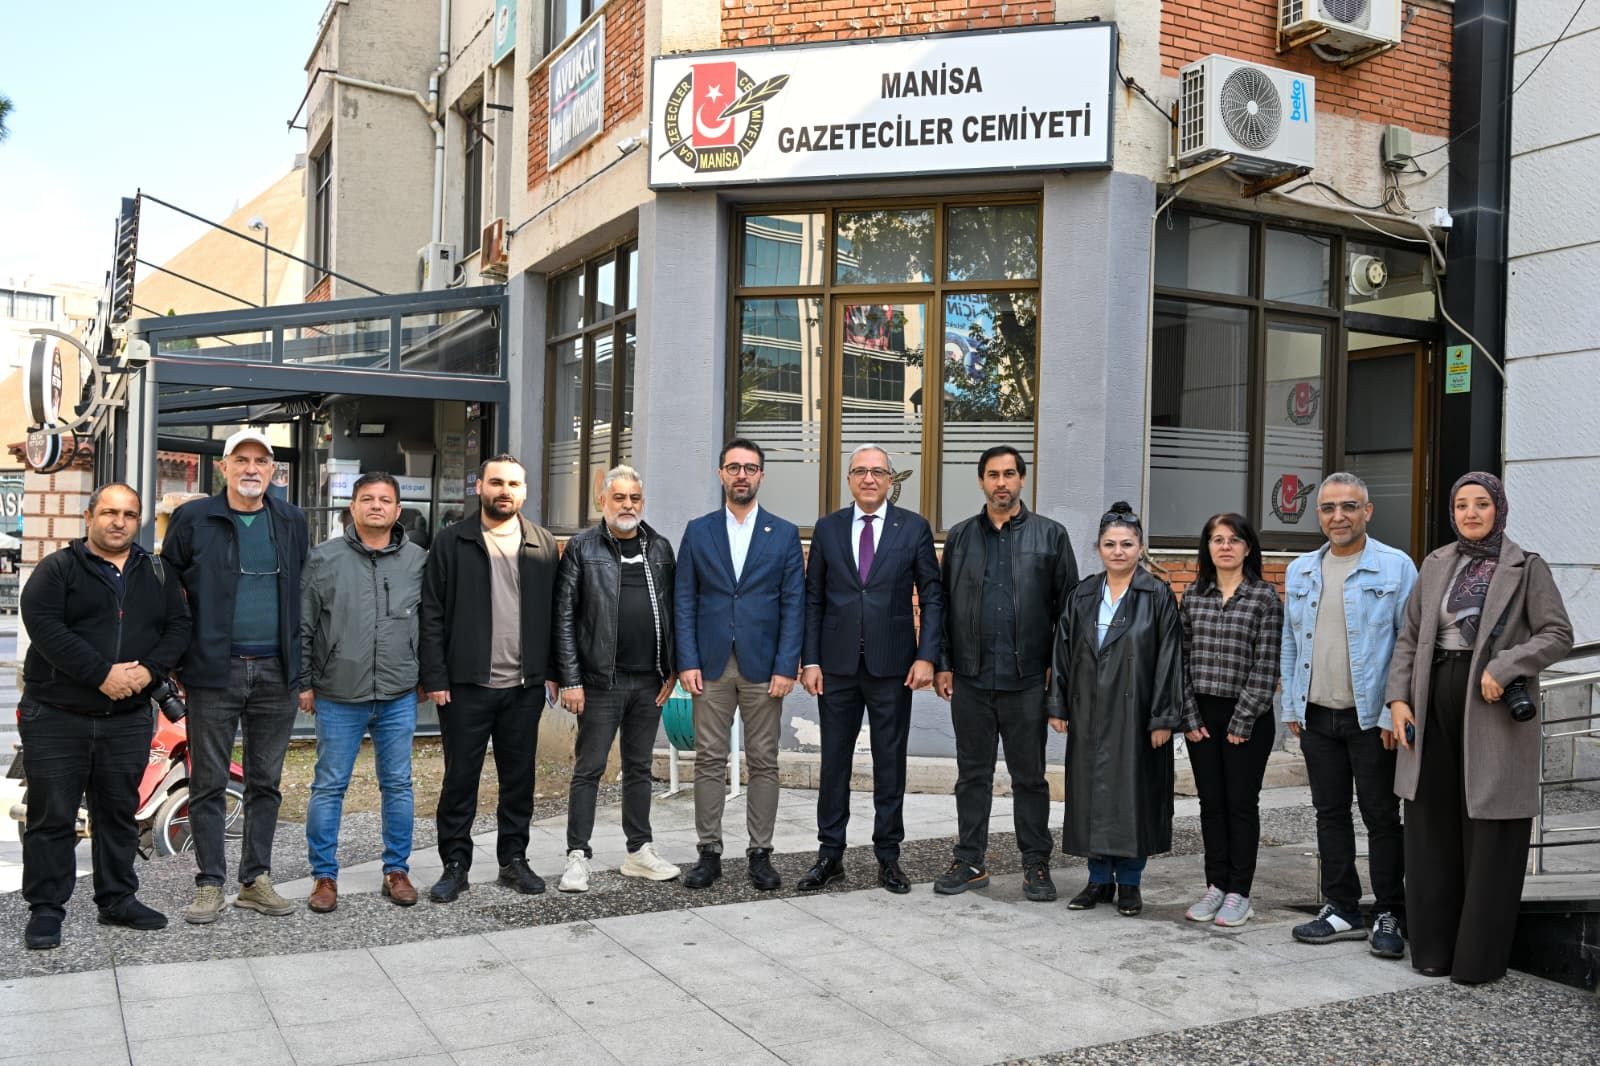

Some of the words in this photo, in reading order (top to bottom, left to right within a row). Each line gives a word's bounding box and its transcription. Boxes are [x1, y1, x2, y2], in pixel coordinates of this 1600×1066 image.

[555, 38, 597, 101] AVUKAT
[881, 62, 982, 99] MANİSA
[1290, 80, 1303, 121] beko
[777, 113, 954, 154] GAZETECİLER
[961, 101, 1092, 143] CEMİYETİ
[700, 149, 740, 169] MANİSA
